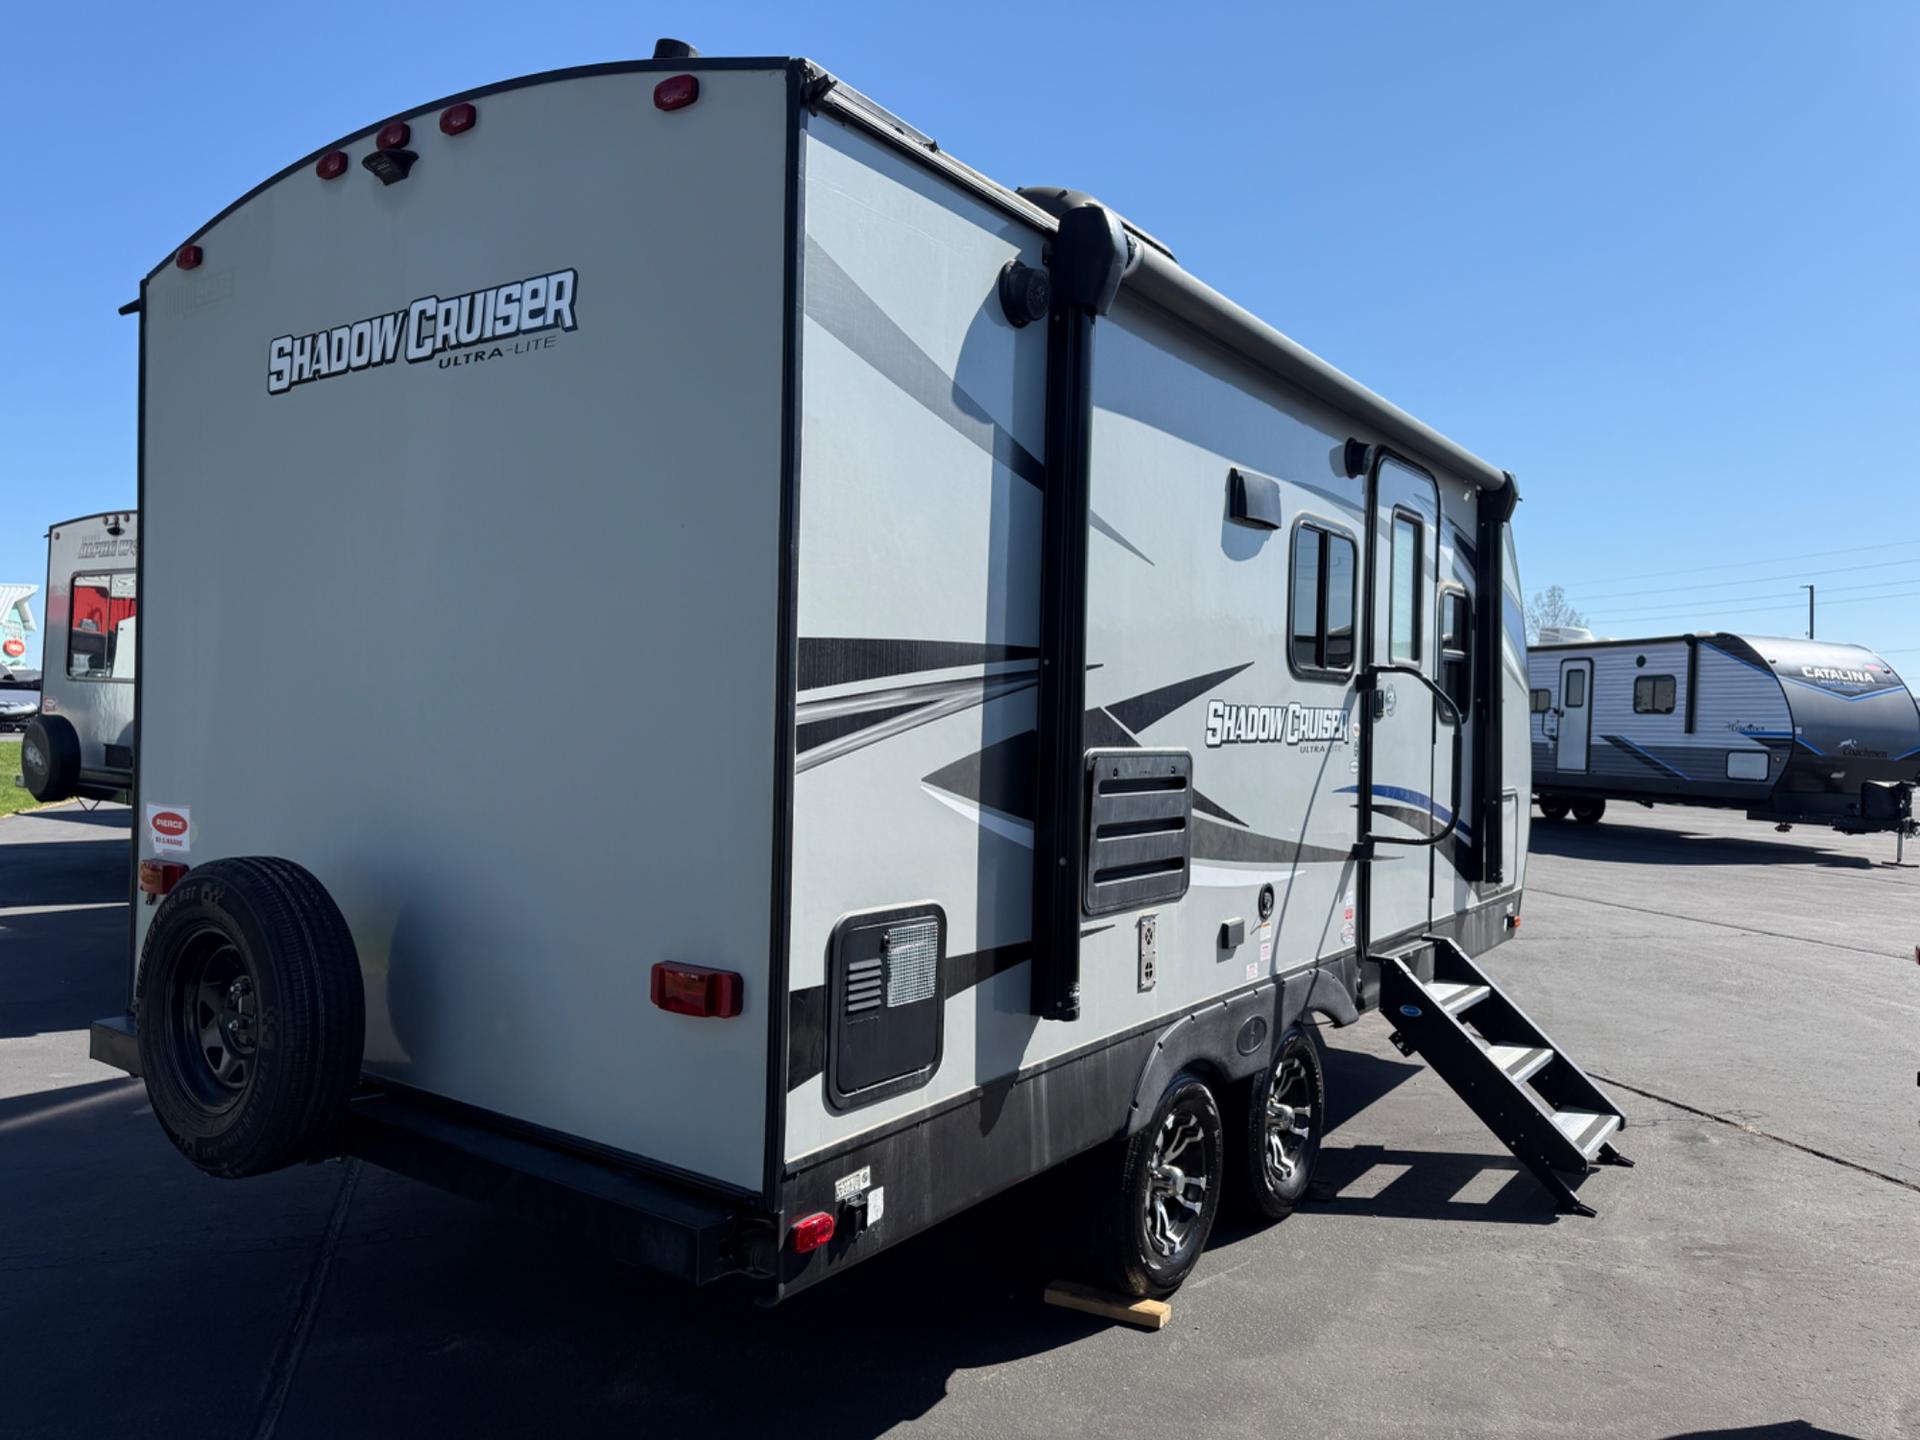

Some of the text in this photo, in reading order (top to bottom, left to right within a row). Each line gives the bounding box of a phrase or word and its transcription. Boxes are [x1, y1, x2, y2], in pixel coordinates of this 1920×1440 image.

[267, 268, 579, 395] SHADOW CRUISER
[438, 335, 558, 369] ULTRA-LITE
[1801, 666, 1876, 684] CATALINA
[1205, 699, 1350, 748] SHADOW CRUISER
